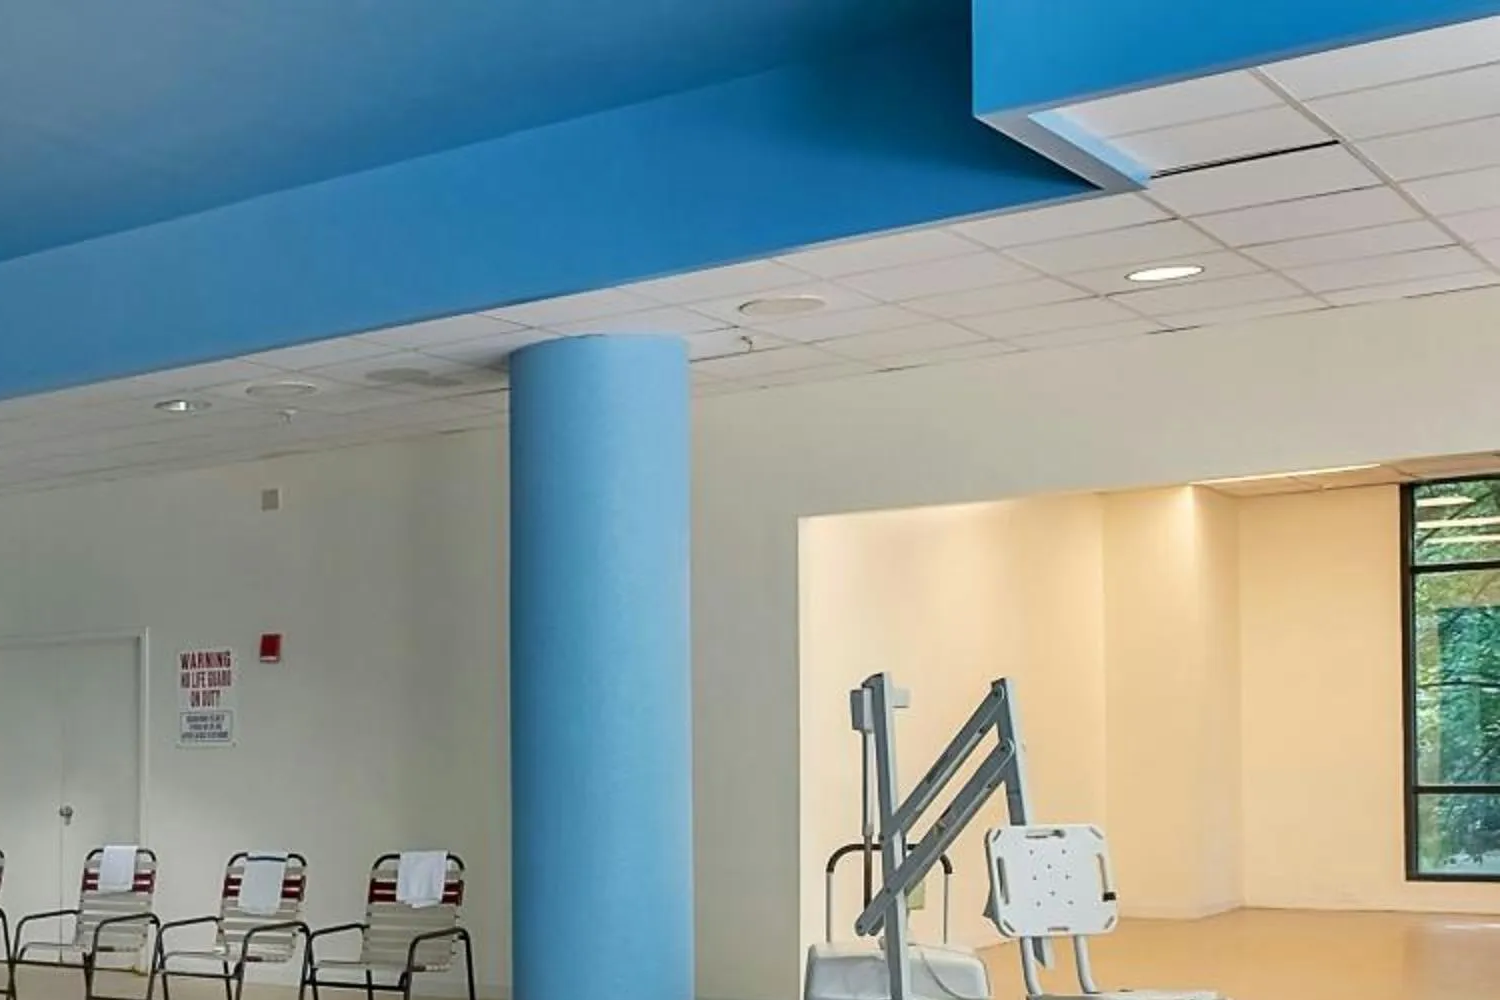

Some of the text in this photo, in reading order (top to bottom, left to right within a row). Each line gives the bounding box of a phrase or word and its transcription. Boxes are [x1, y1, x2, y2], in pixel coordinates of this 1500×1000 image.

[180, 651, 230, 669] WARNING
[181, 669, 231, 688] NO LIFE GUARD
[191, 689, 220, 707] ON DUTY
